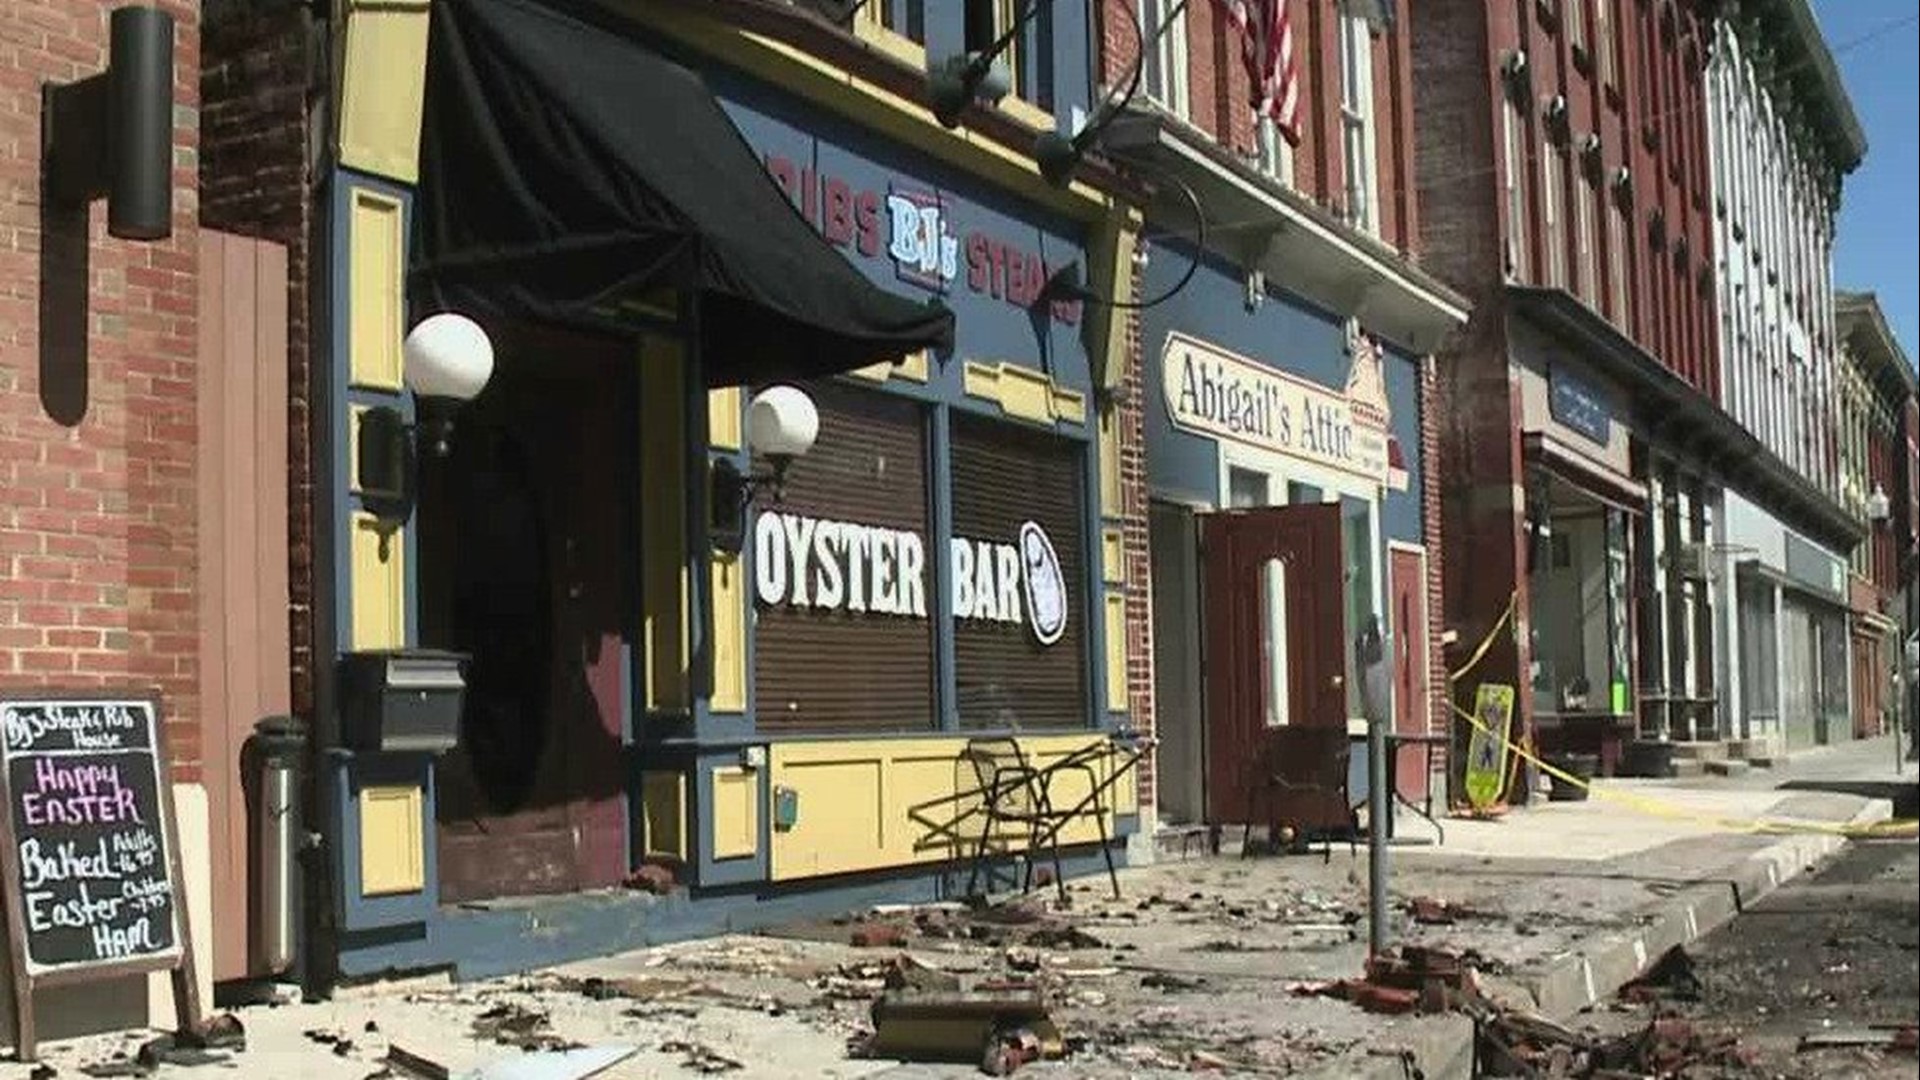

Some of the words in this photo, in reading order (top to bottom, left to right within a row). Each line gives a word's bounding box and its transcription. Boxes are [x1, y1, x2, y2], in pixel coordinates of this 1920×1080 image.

[888, 195, 958, 280] BJ's
[967, 230, 1082, 326] STEA
[1178, 353, 1291, 446] Abigail's
[1301, 397, 1352, 460] Attic
[756, 511, 927, 618] OYSTER
[950, 537, 1022, 623] BAR
[73, 727, 121, 748] House
[104, 706, 133, 729] Rib
[20, 837, 120, 889] Baked
[25, 881, 123, 932] Easter
[94, 916, 160, 959] HAM
